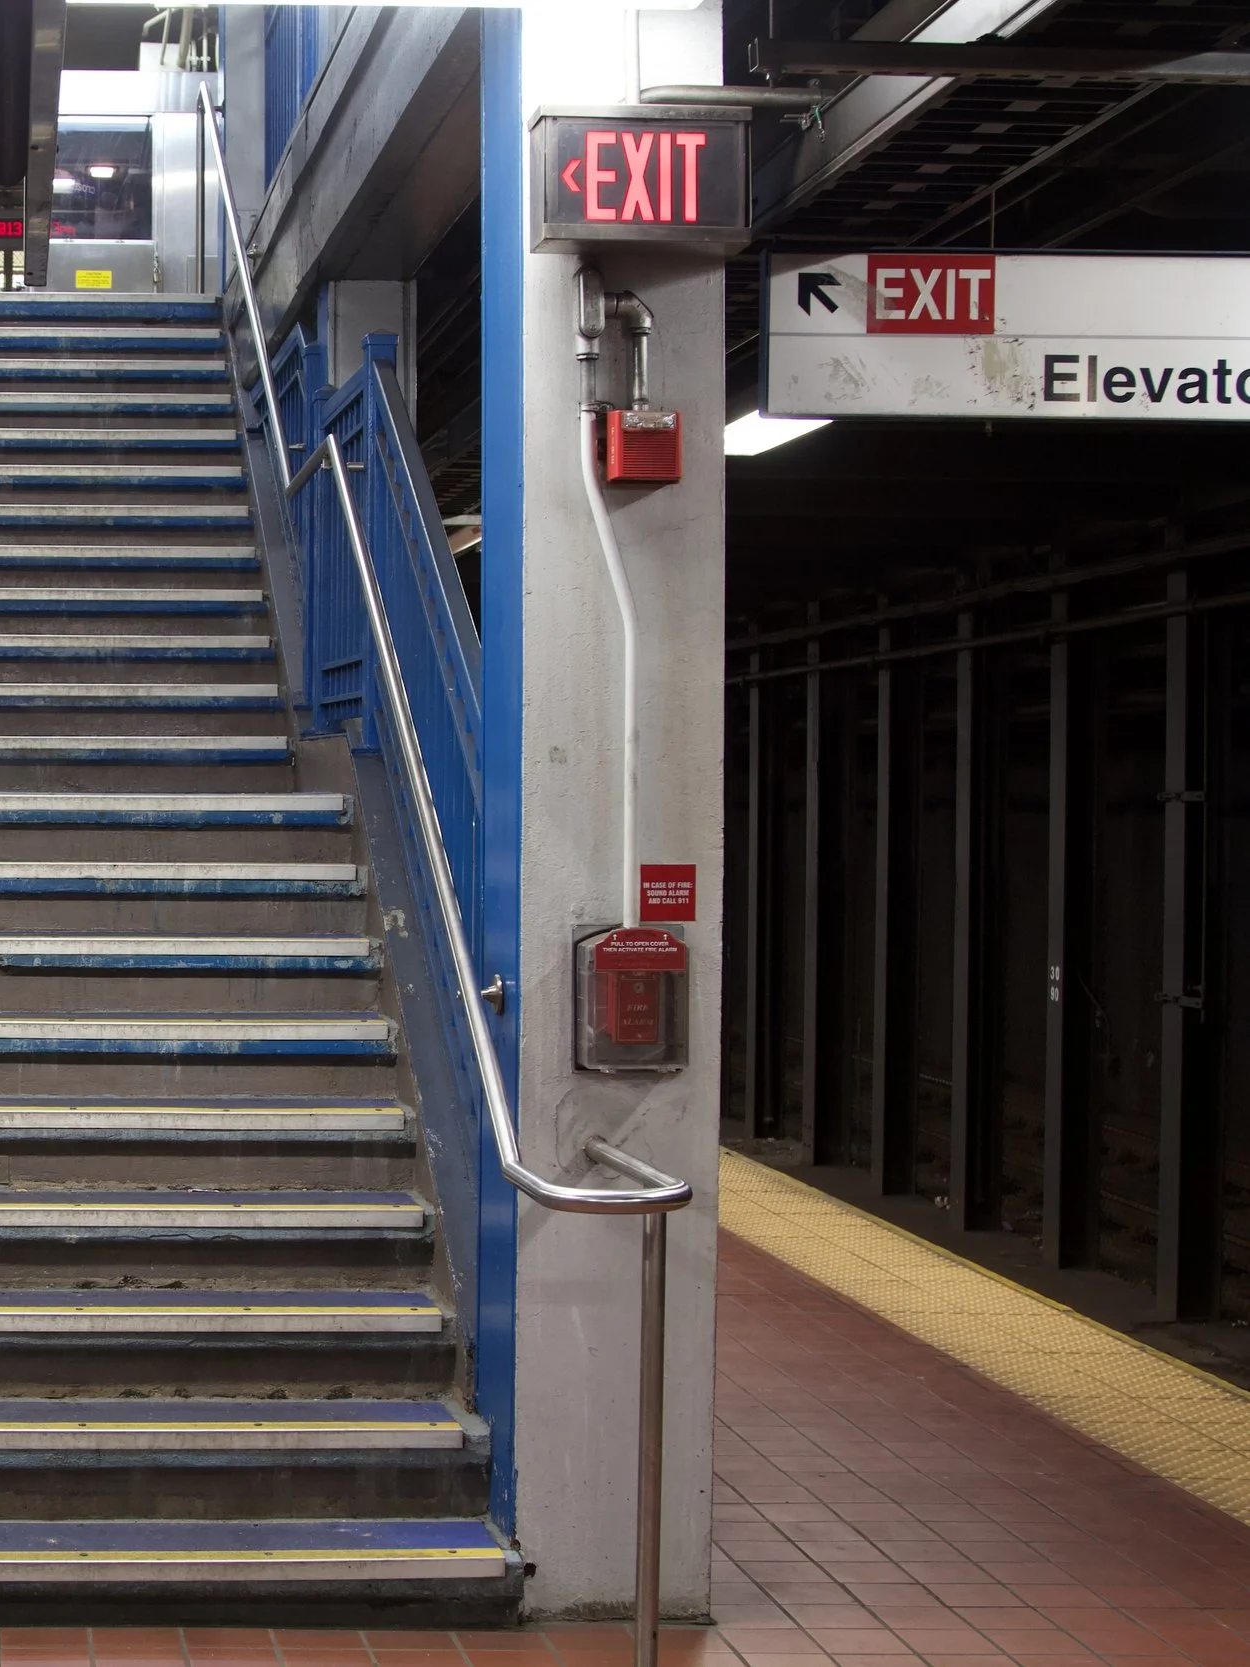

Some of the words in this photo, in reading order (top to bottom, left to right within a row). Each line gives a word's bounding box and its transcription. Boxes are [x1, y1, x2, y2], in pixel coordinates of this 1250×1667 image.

[584, 130, 707, 223] EXIT
[875, 268, 992, 321] EXIT
[643, 881, 650, 889] IN
[651, 881, 667, 889] CASE
[668, 881, 676, 889] OF
[677, 881, 693, 889] FIRE:
[646, 889, 667, 897] SOUND
[668, 889, 689, 897] ALARM
[648, 897, 661, 905] AND
[662, 897, 677, 905] CALL
[1050, 965, 1060, 981] 30
[1050, 986, 1059, 1002] 90
